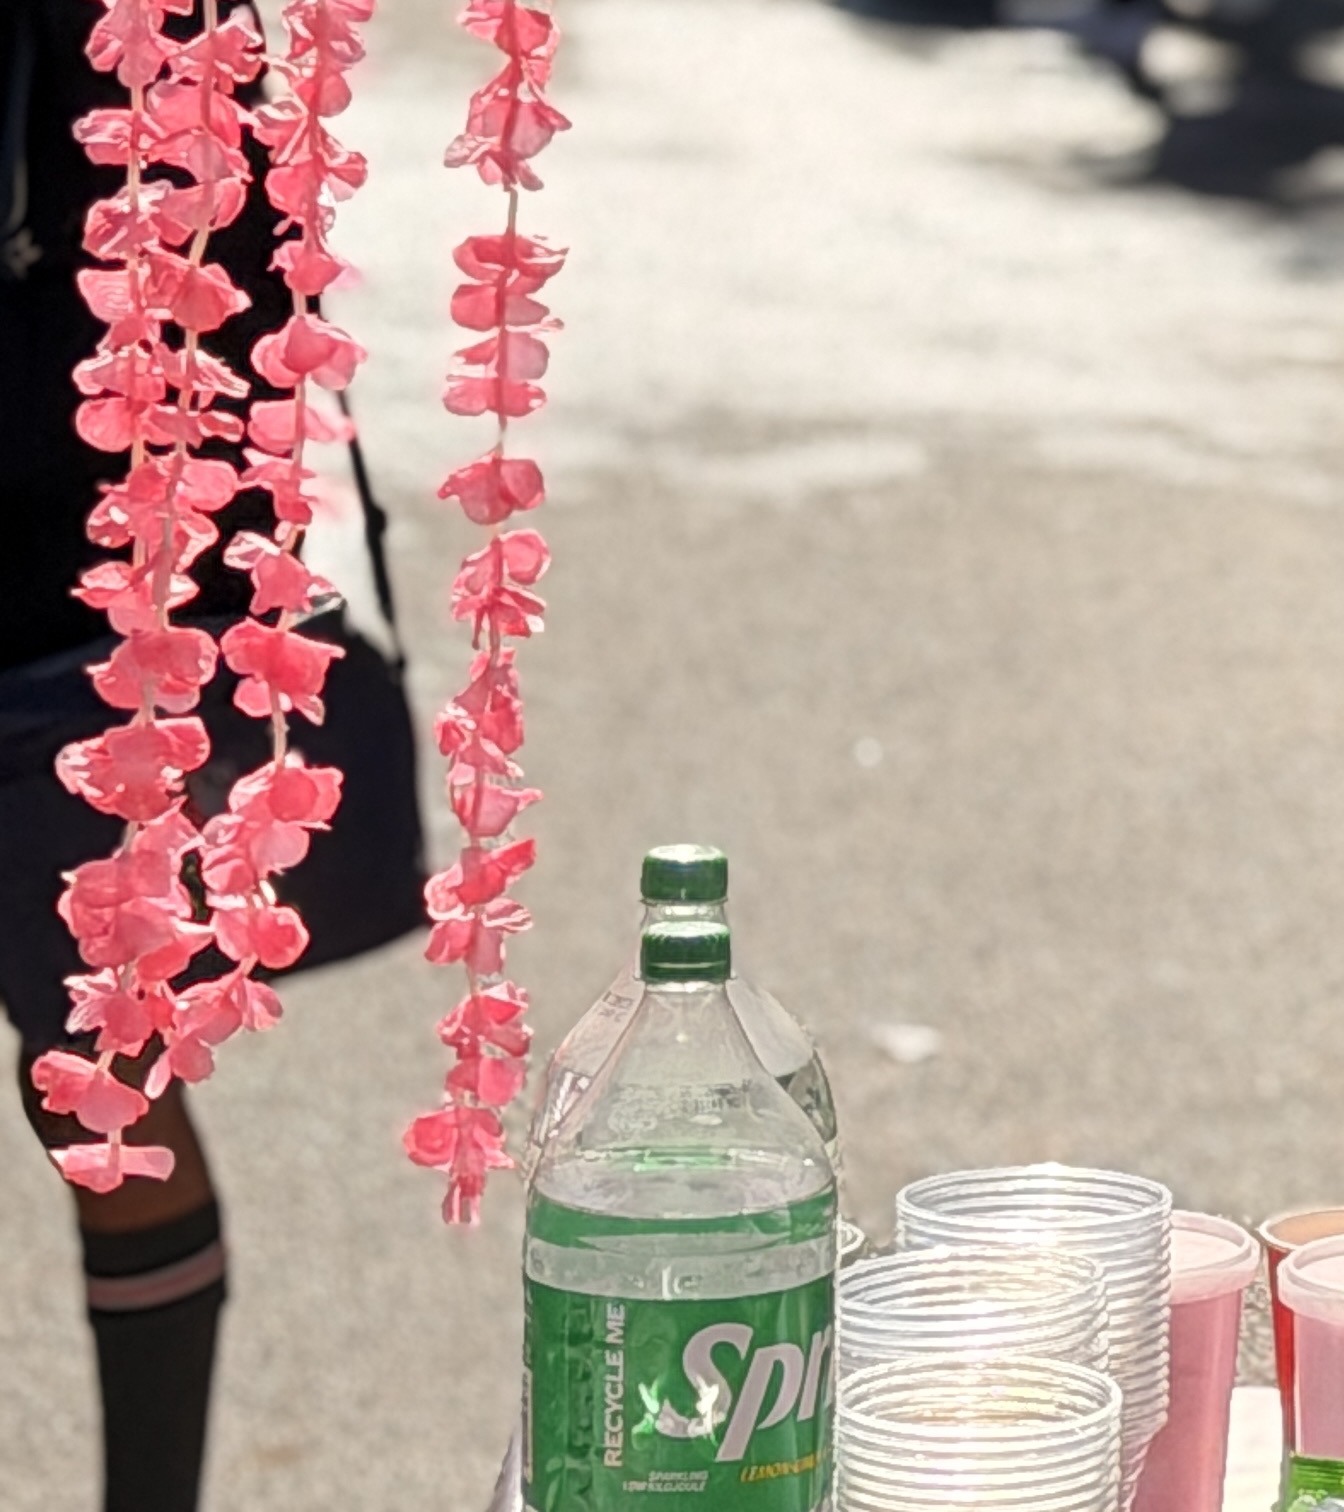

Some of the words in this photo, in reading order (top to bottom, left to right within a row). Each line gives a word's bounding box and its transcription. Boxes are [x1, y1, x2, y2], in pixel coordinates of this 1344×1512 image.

[605, 1303, 625, 1344] ME
[604, 1350, 624, 1467] RECYCLE
[654, 1321, 833, 1463] Spr
